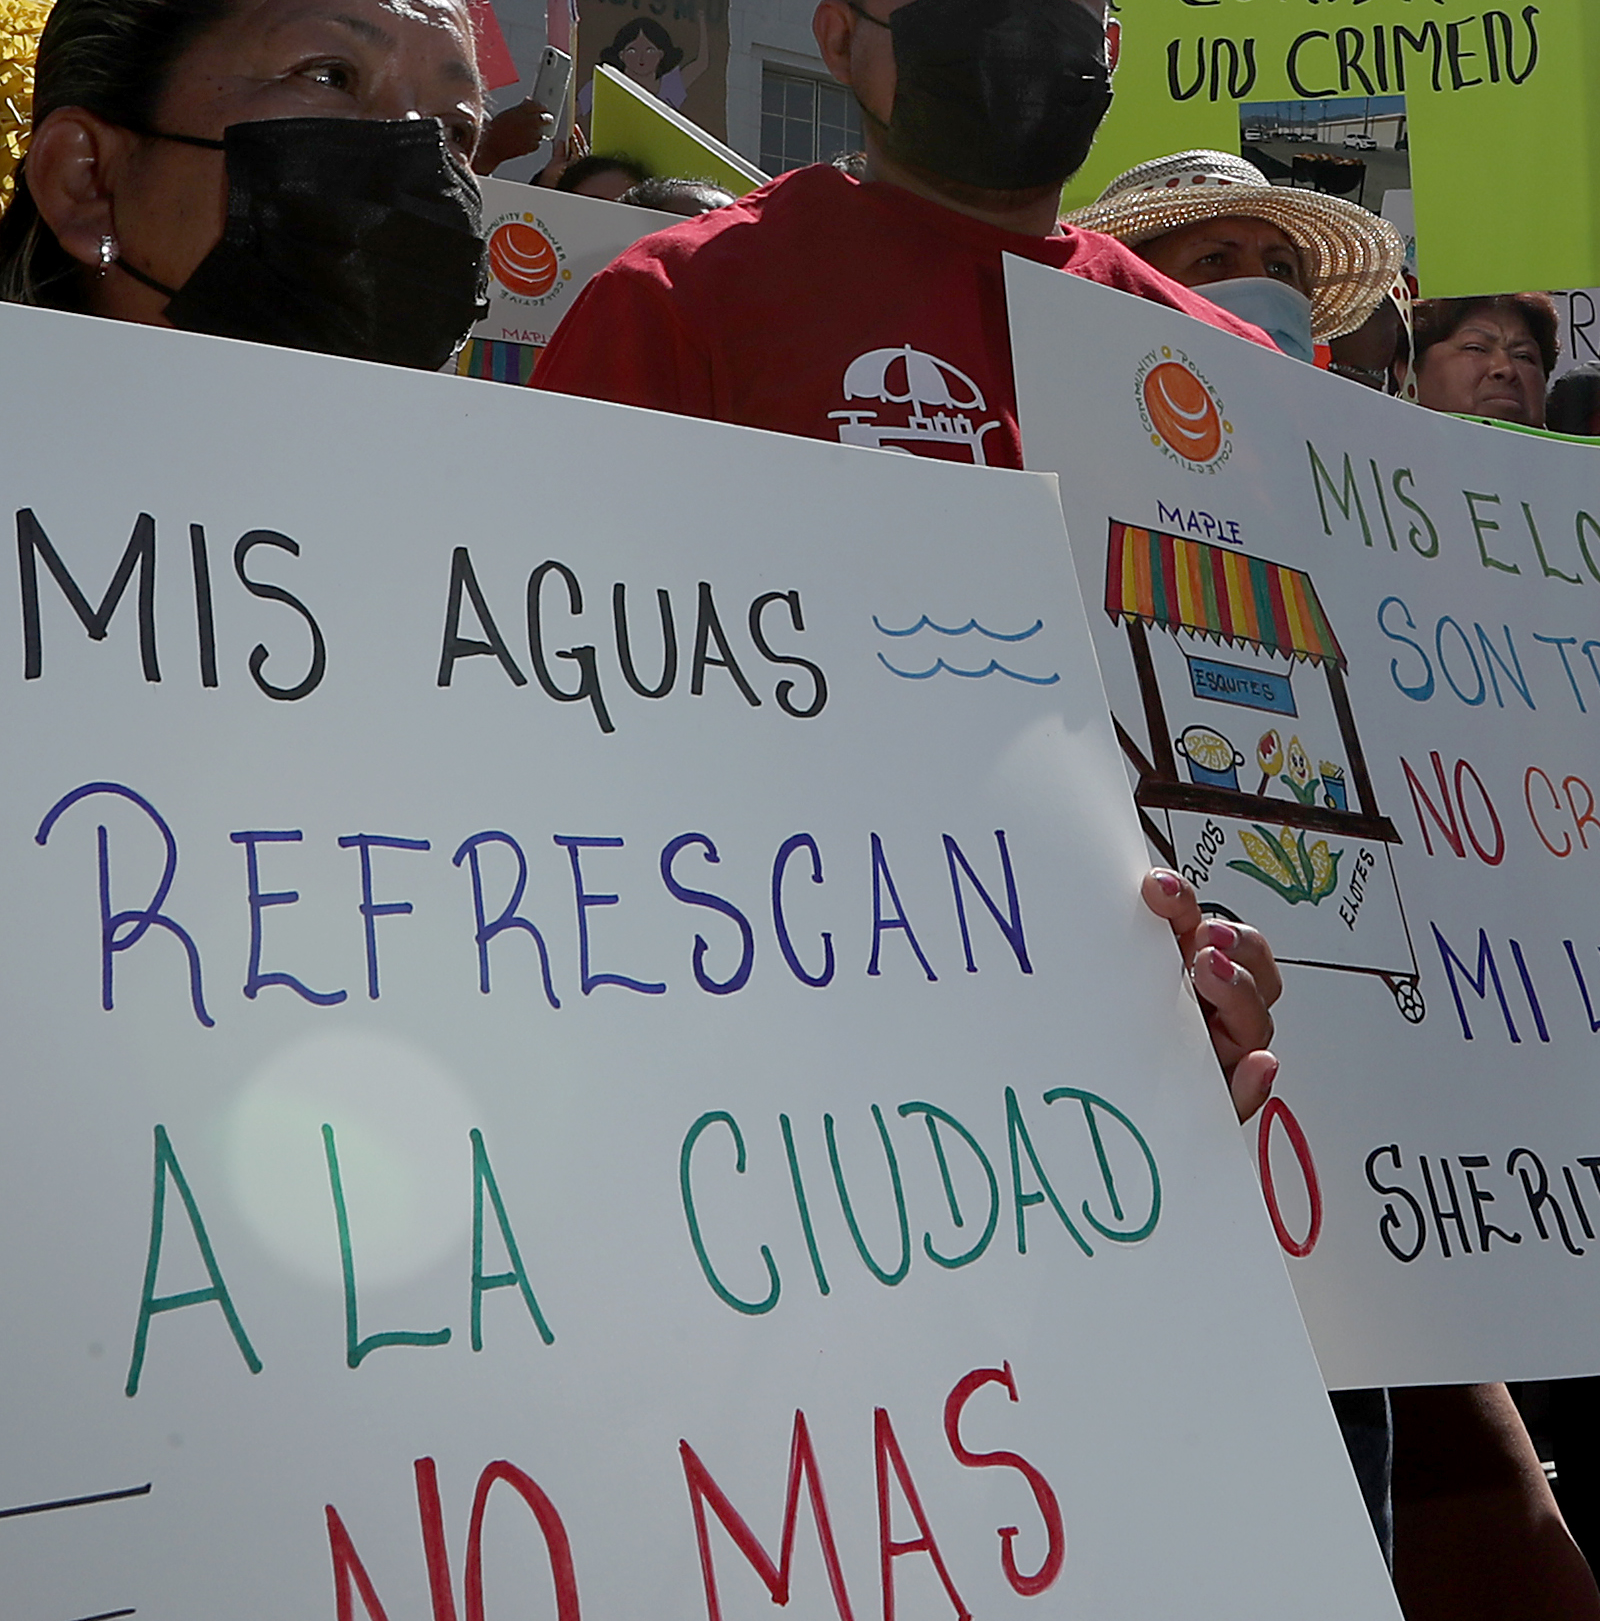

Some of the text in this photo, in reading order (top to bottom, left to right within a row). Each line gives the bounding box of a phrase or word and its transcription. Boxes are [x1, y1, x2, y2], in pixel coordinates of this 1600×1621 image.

[1167, 4, 1541, 102] UN CRIMEN
[1134, 349, 1232, 475] COMMUNITY POWER COLLECTIVE
[1157, 499, 1243, 545] MAPLE
[1305, 440, 1439, 561] MIS
[15, 507, 828, 733] MIS AGUAS
[1378, 596, 1528, 711] SON
[1194, 668, 1275, 701] ESQUITES
[1183, 819, 1225, 890] RICOS
[1400, 750, 1505, 867] NO
[34, 781, 1036, 1028] REFRESCAN
[1338, 847, 1376, 932] ELOTES
[1432, 920, 1551, 1046] MI
[124, 1085, 1163, 1398] A LA CIUDAD
[324, 1361, 1066, 1621] NO MAS
